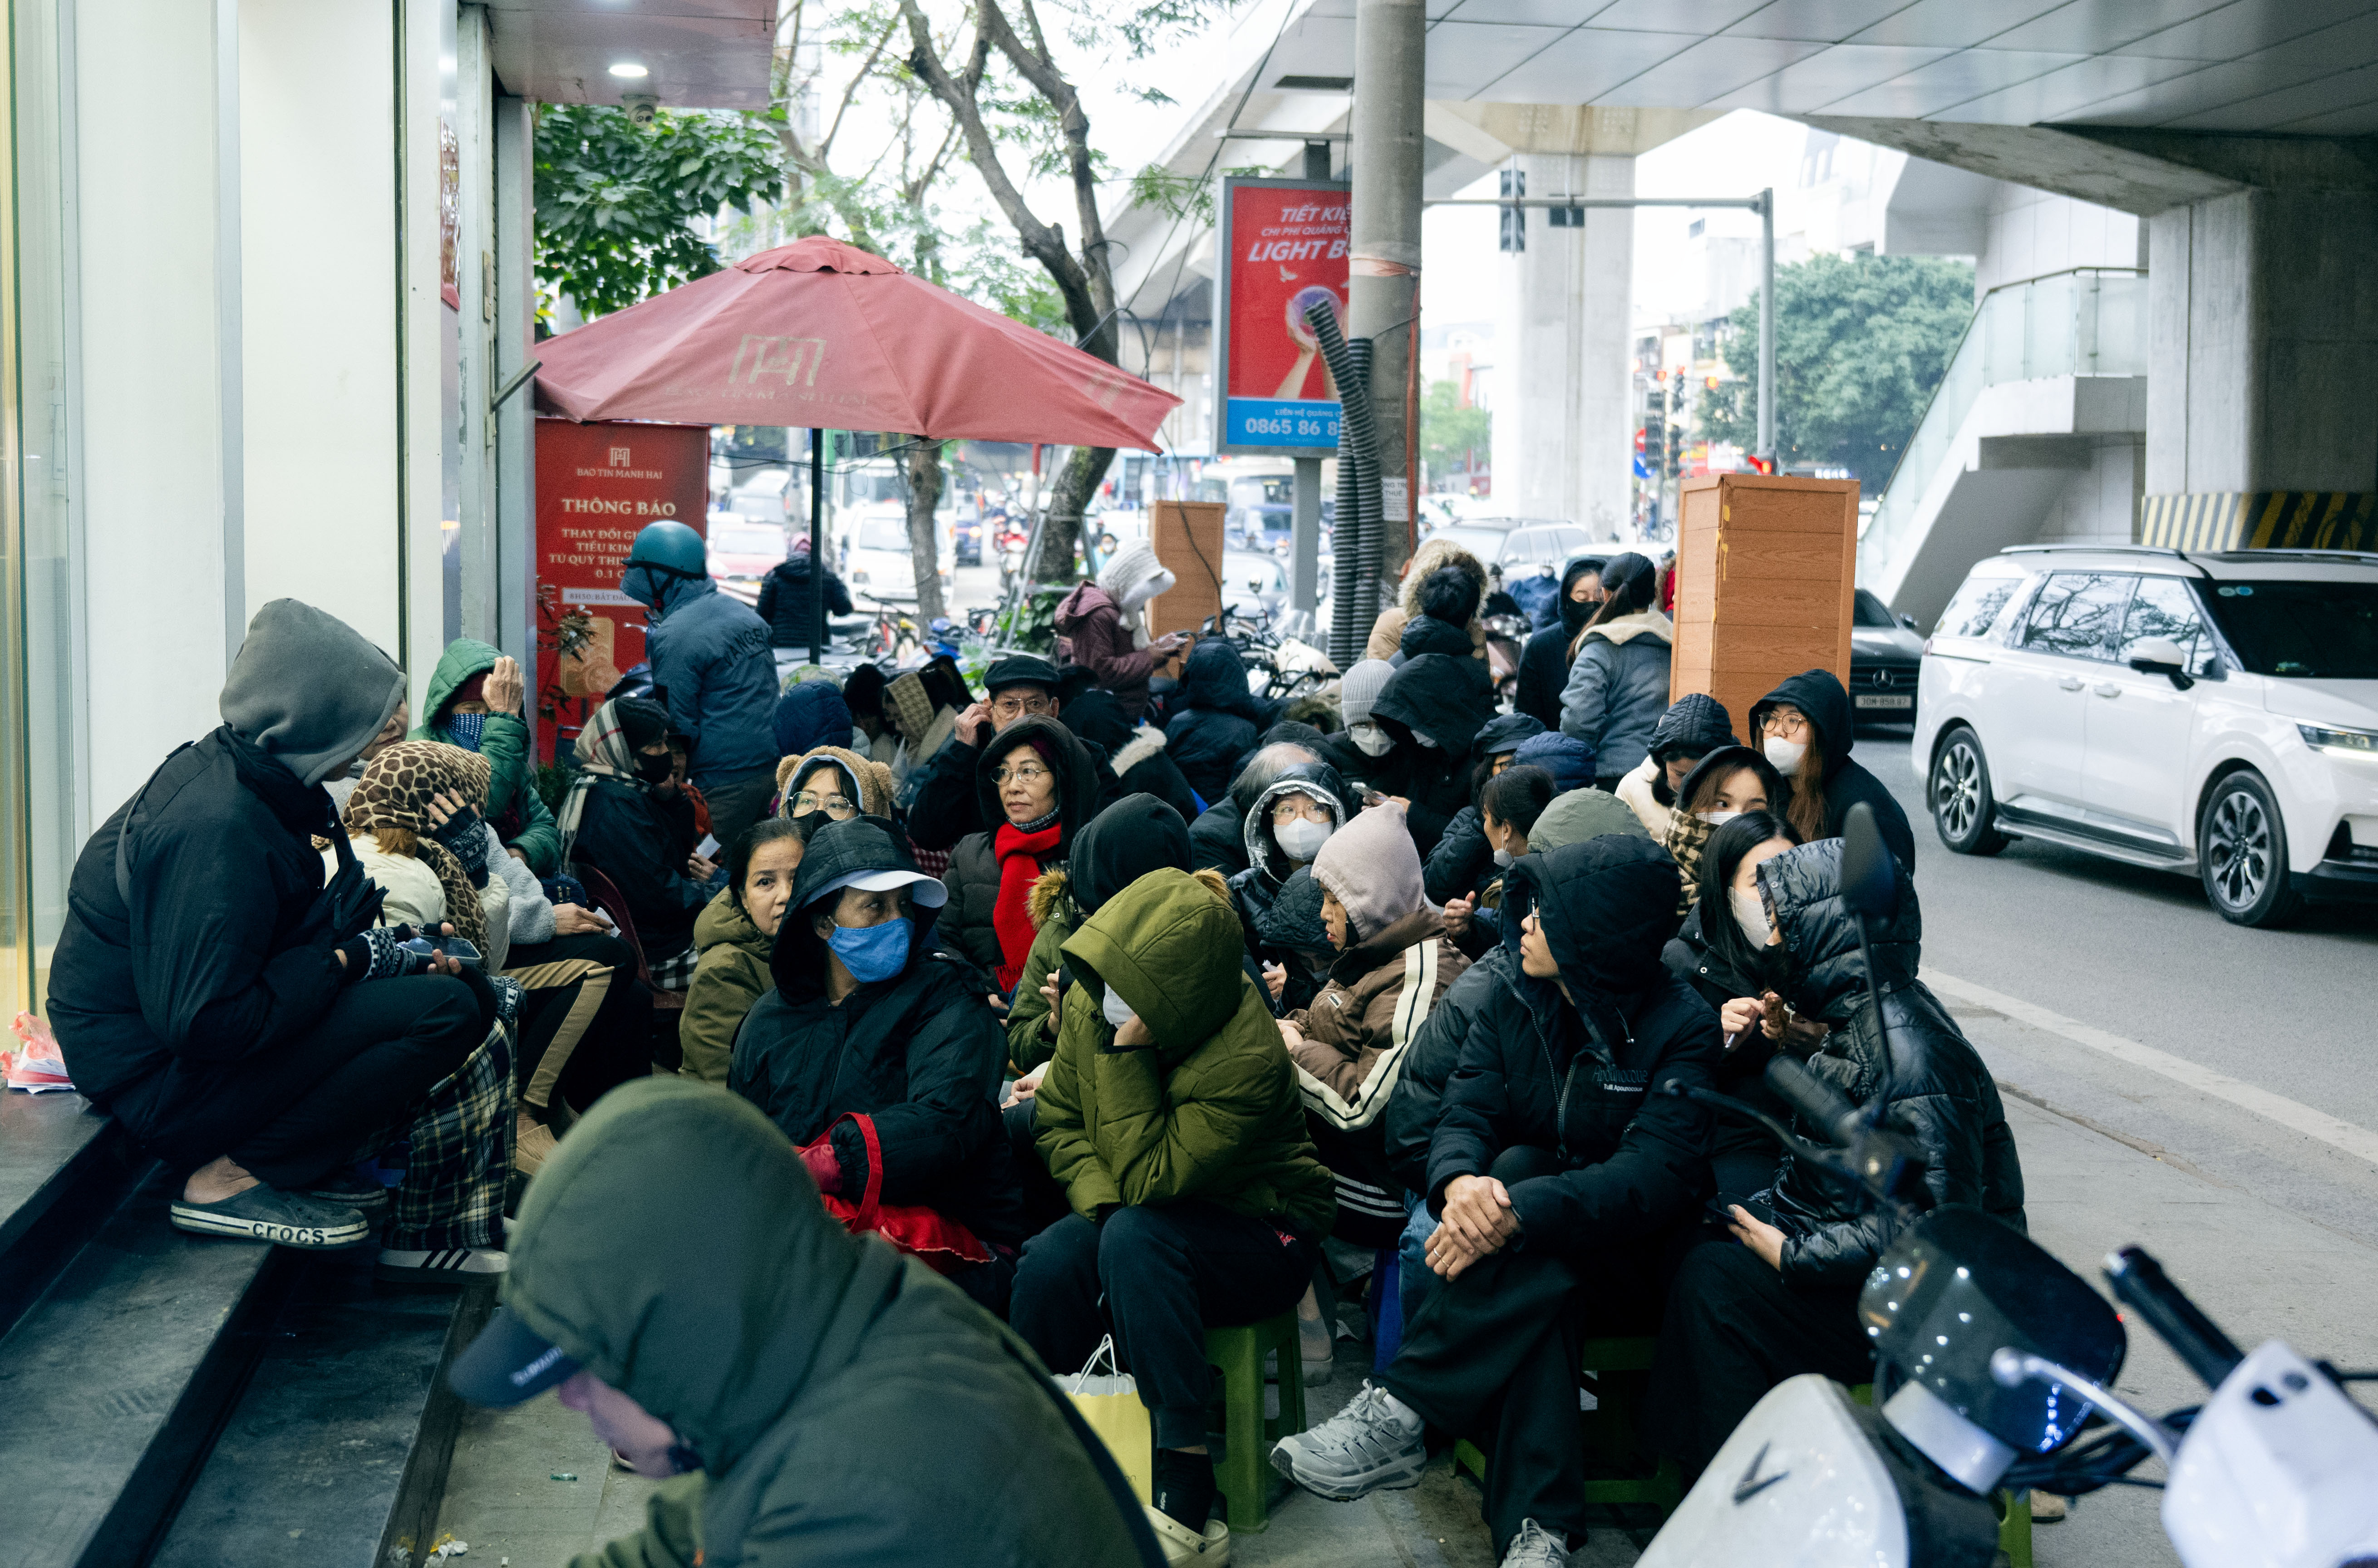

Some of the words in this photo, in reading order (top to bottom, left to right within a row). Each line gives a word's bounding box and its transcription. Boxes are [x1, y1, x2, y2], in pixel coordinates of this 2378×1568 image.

[1281, 203, 1320, 222] TIẾT
[1321, 203, 1351, 224] KIỆ
[1261, 227, 1280, 236] CHI
[1248, 240, 1328, 262] LIGHT
[1246, 418, 1292, 434] 0865
[1298, 420, 1321, 435] 86
[1327, 421, 1340, 436] 8
[561, 497, 632, 514] THÔNG
[637, 499, 676, 516] BÁO
[562, 528, 596, 539] THAY
[624, 531, 637, 540] GI
[609, 544, 632, 553] KIM
[598, 556, 623, 567] THỊ
[596, 570, 613, 578] 0.1
